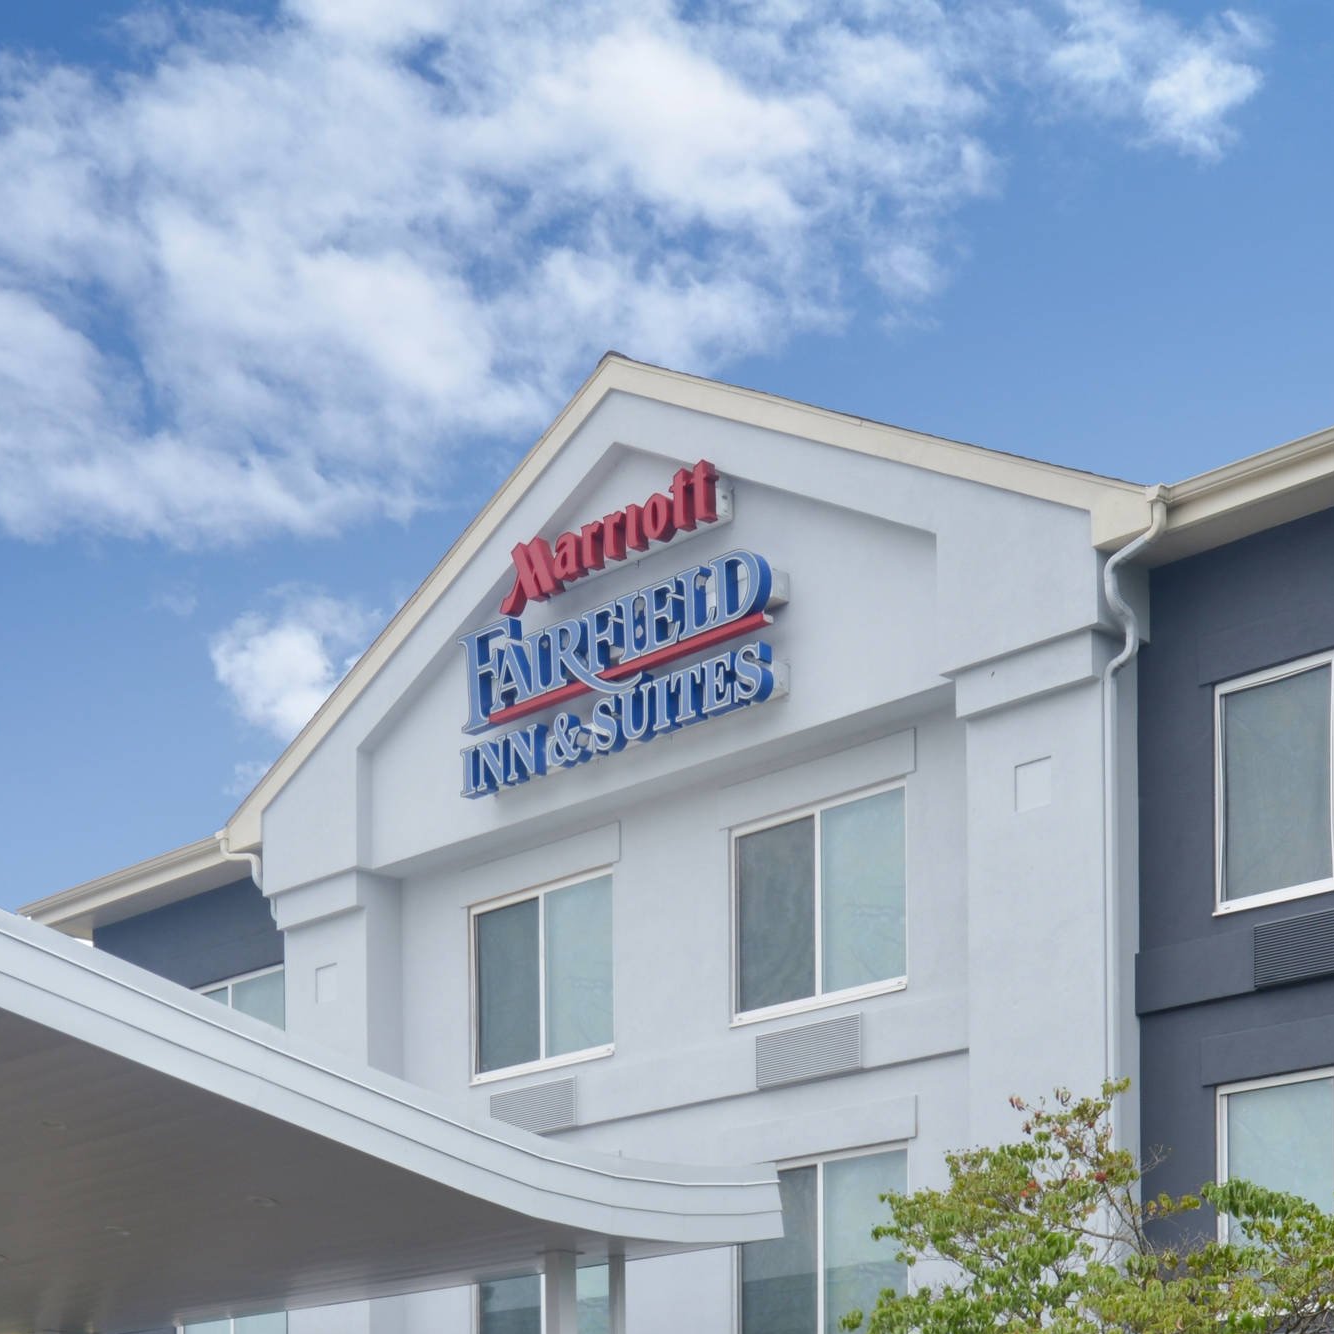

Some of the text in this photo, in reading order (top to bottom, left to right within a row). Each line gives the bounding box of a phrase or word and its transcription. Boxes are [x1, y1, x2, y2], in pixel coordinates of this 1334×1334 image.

[499, 459, 719, 617] Marriott
[457, 548, 773, 735] FAIRFIELD
[460, 641, 774, 799] INN & SUITES
